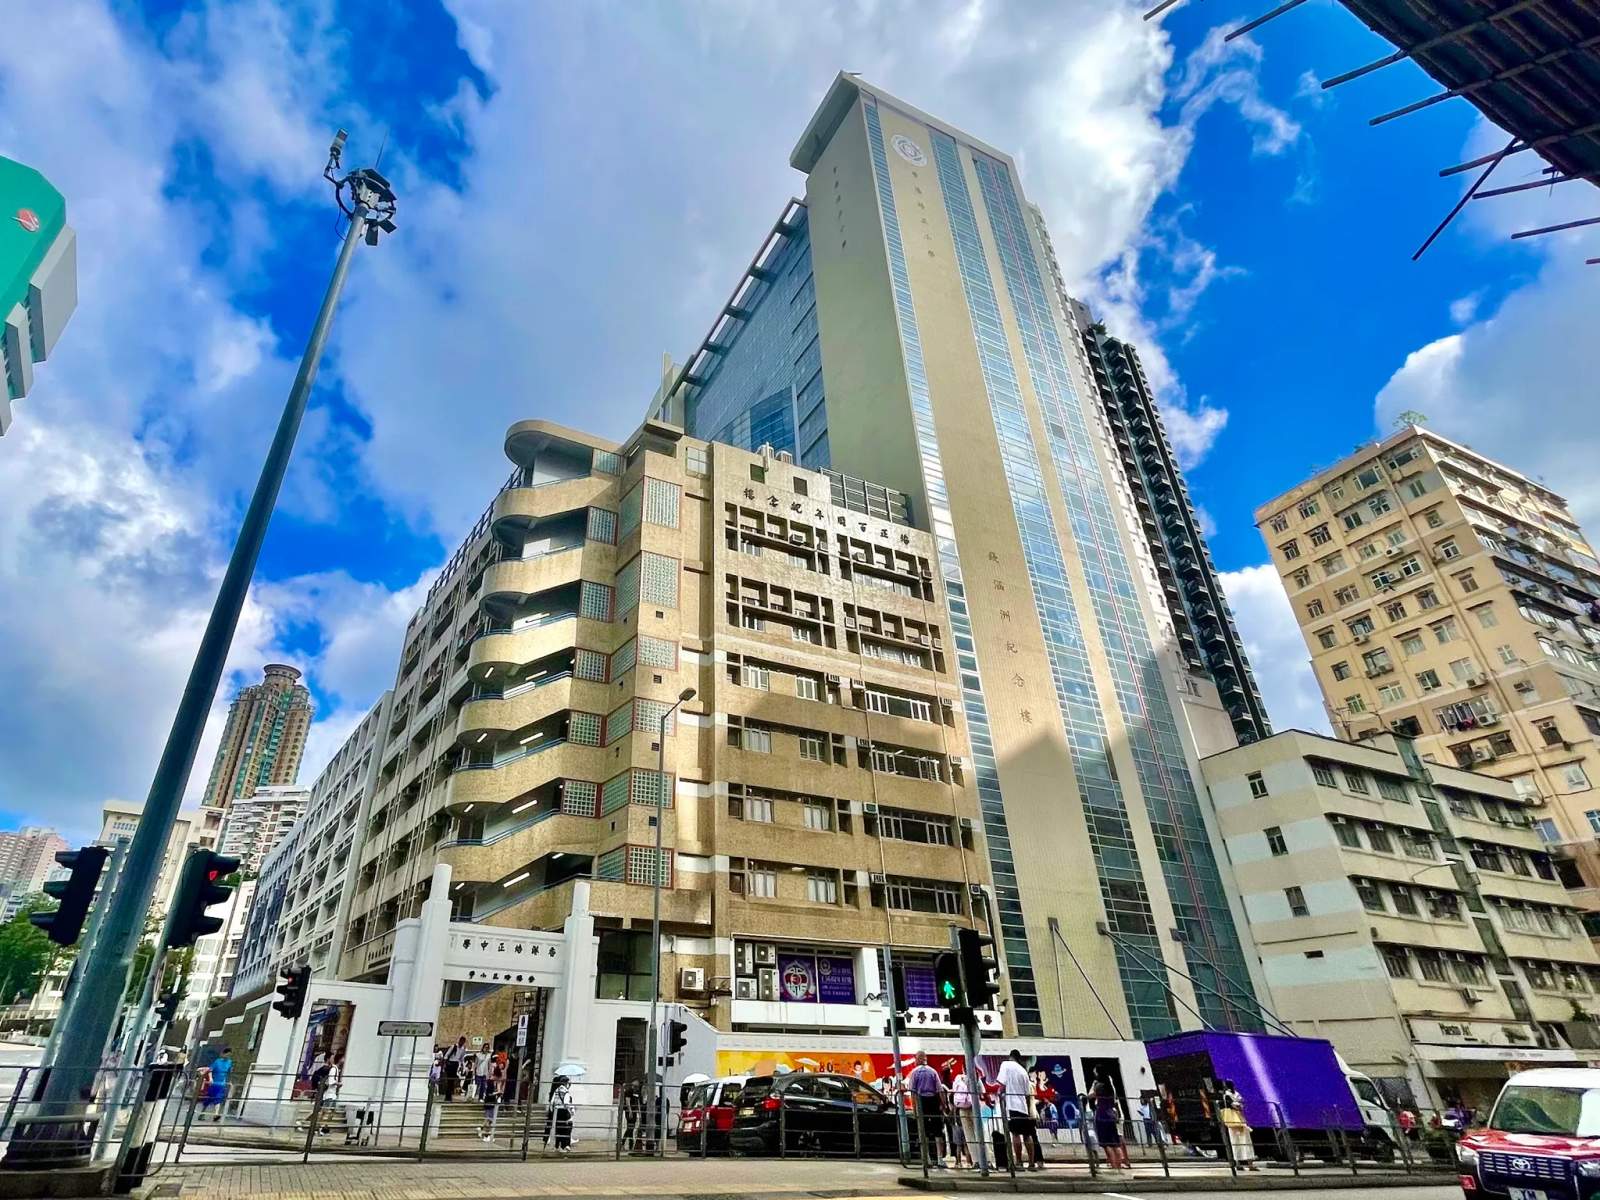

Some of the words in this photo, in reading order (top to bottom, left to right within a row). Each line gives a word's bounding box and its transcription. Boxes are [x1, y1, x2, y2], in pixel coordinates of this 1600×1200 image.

[462, 939, 557, 957] 香港培正中學
